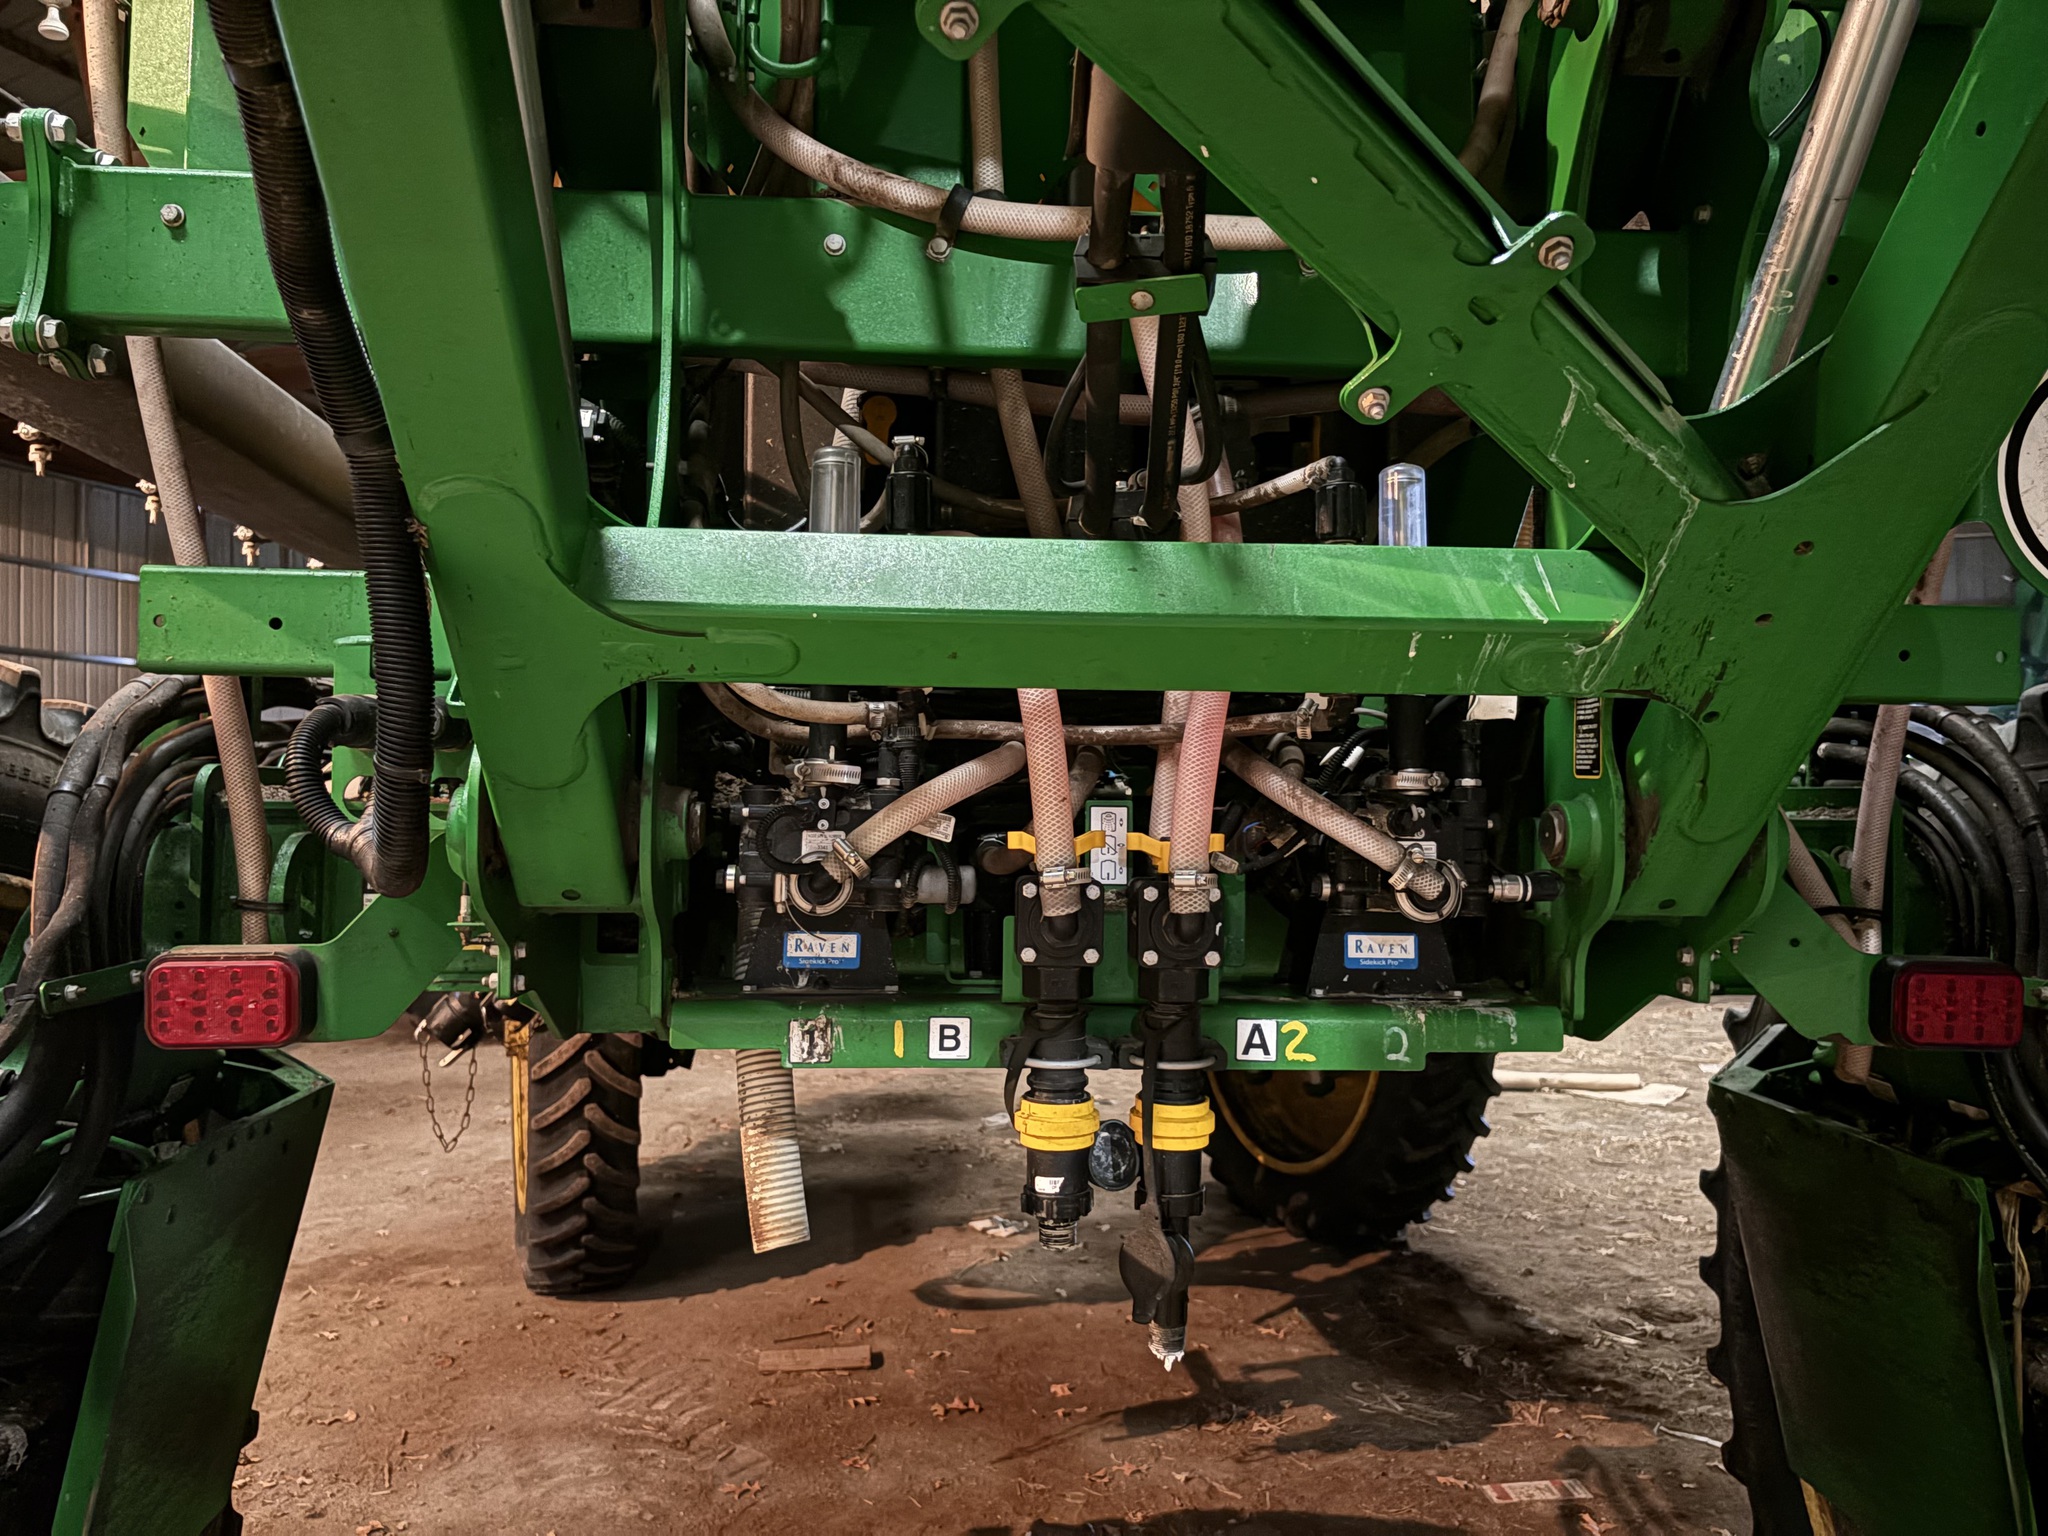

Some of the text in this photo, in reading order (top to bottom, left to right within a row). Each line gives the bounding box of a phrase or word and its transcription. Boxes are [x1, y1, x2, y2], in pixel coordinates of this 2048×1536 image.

[795, 938, 850, 953] RAVEN
[1355, 939, 1408, 954] RAVEN
[939, 1024, 961, 1052] B
[1241, 1023, 1271, 1056] A
[1280, 1020, 1317, 1062] 2
